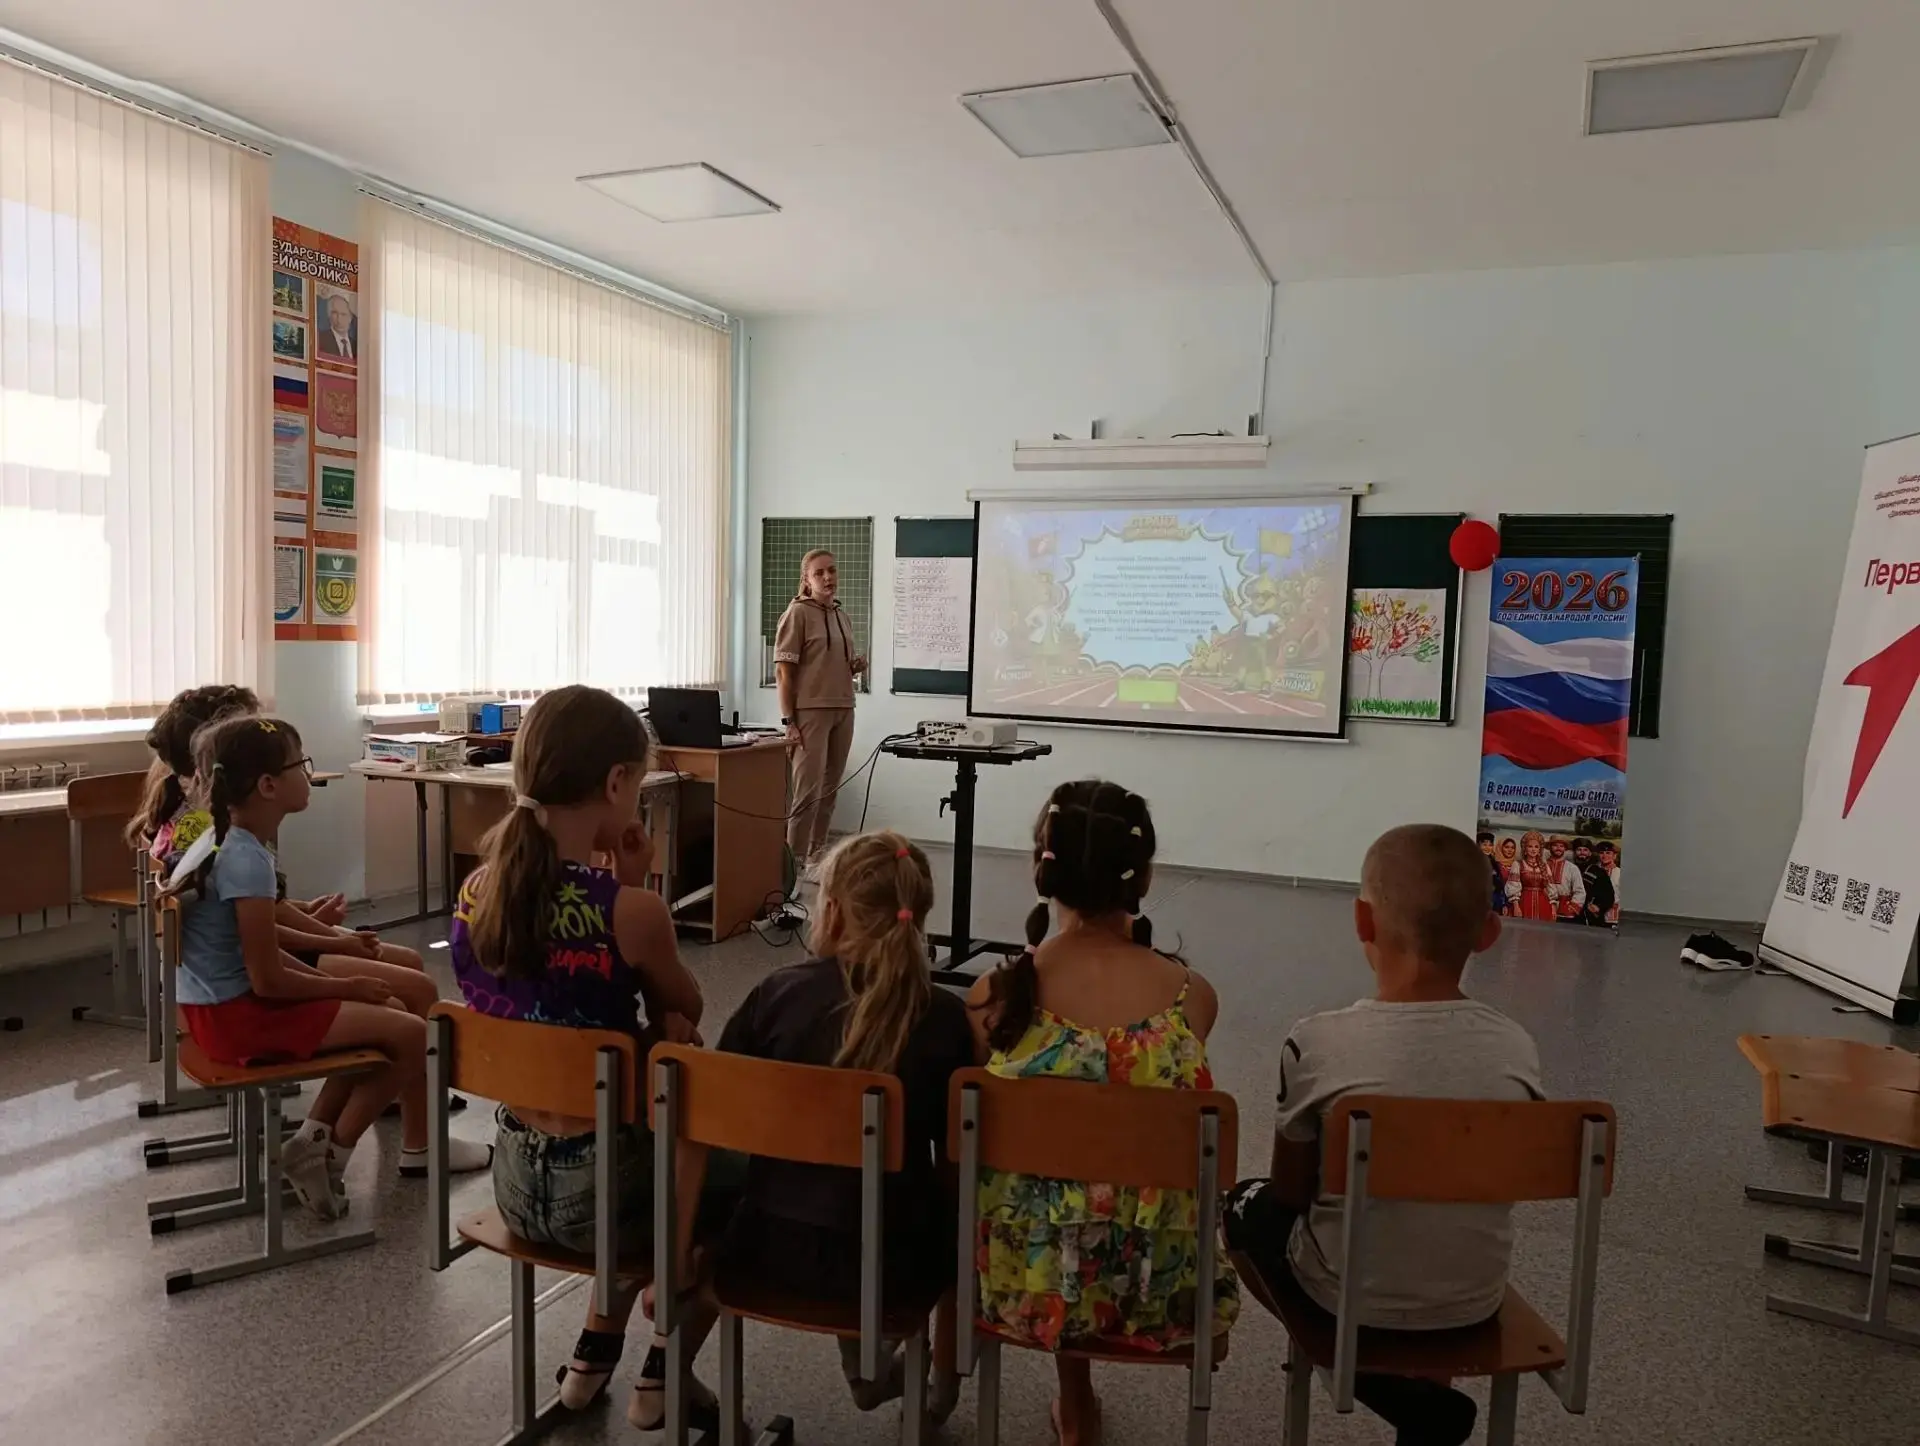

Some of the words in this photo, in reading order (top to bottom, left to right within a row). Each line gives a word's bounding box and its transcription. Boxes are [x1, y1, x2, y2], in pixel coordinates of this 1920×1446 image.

[272, 252, 350, 286] СИМВОЛИКА
[1864, 558, 1920, 595] Перв
[1499, 571, 1629, 610] 2026
[1497, 612, 1513, 623] ГОД
[1514, 612, 1553, 623] ЕДИНСТВА
[1554, 612, 1590, 623] НАРОДОВ
[1486, 780, 1496, 794] В
[1496, 784, 1545, 799] единстве
[1557, 788, 1584, 801] наша
[1484, 800, 1491, 811] в
[1493, 801, 1536, 816] сердцах
[1547, 805, 1573, 818] одна
[1575, 805, 1619, 820] Россия!
